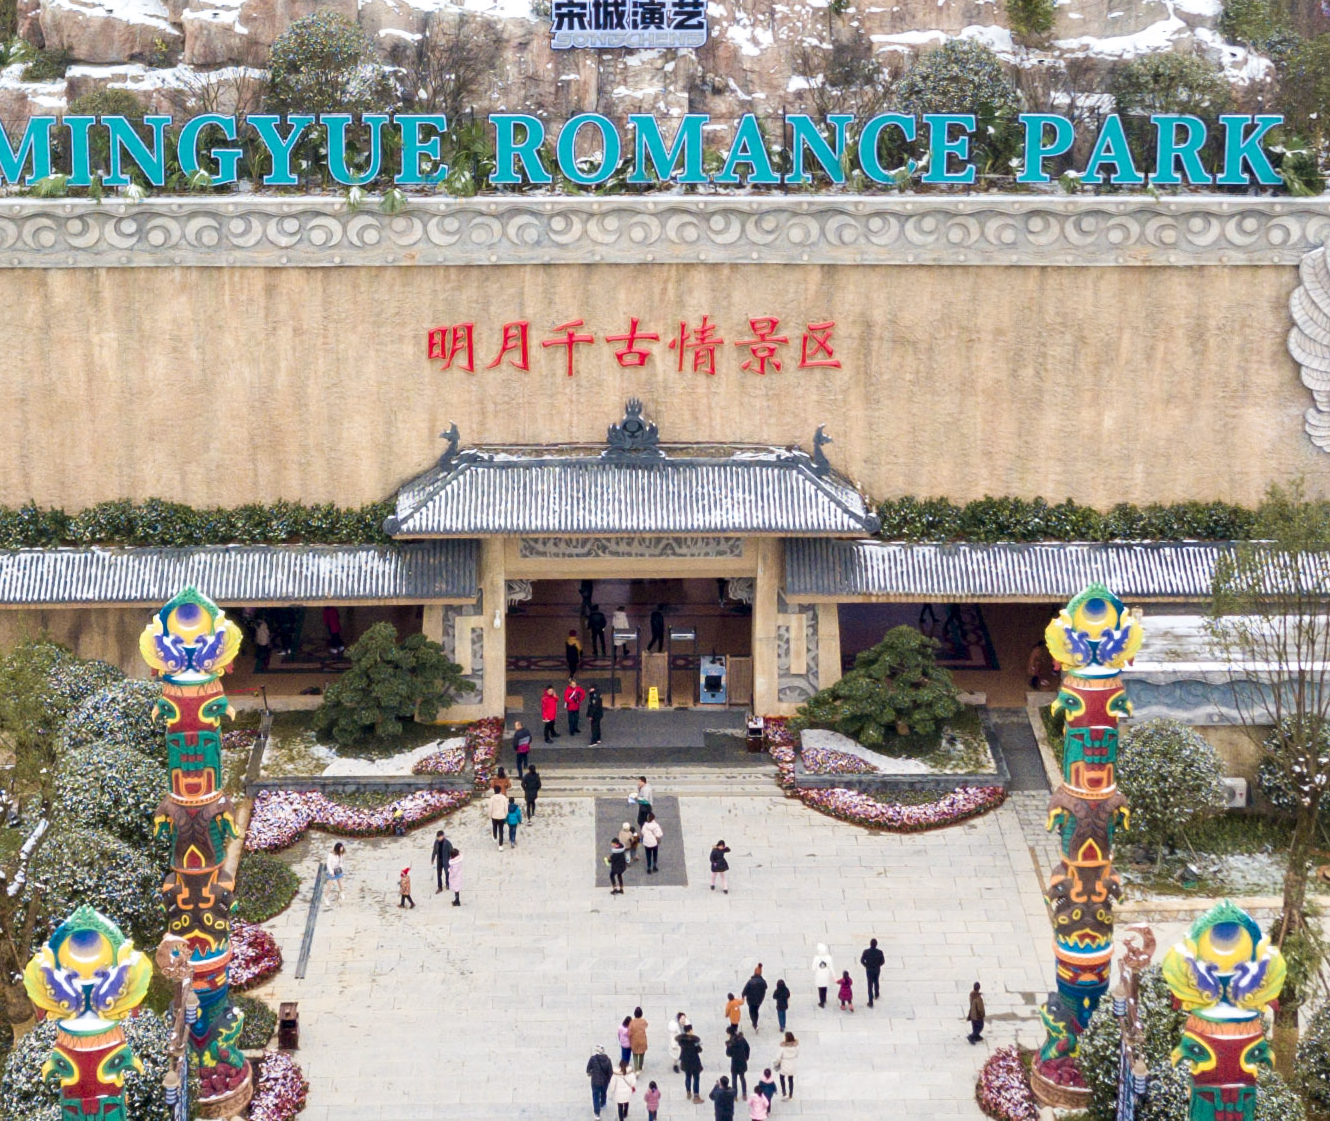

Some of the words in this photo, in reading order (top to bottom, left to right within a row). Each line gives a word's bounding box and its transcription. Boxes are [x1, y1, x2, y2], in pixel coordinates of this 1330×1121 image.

[552, 30, 706, 48] SONGCHENG
[488, 112, 977, 186] ROMANCE
[1016, 112, 1285, 186] PARK
[425, 313, 843, 377] 明月千古情景区
